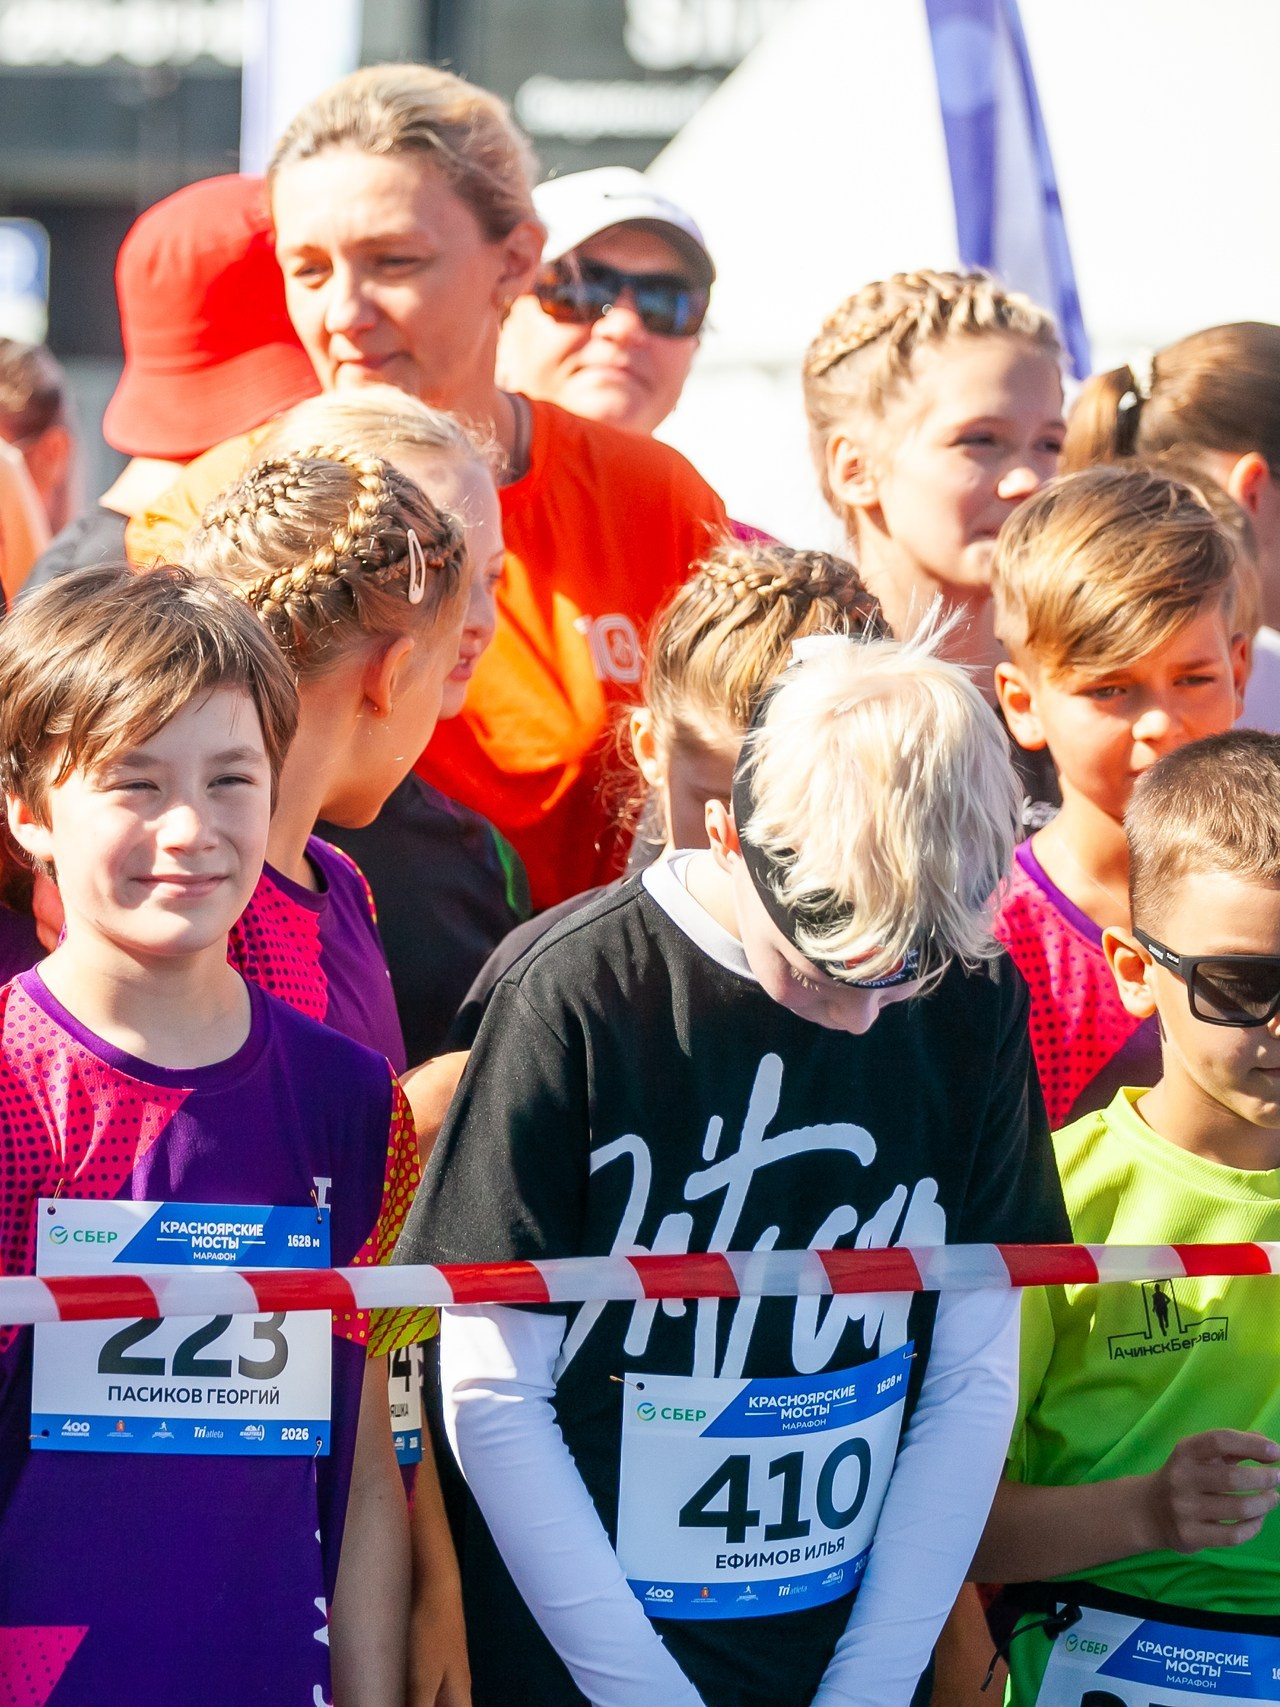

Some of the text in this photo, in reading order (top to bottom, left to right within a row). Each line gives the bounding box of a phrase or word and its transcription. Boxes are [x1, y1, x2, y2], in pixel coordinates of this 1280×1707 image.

[73, 1229, 118, 1244] СБЕР
[160, 1221, 264, 1237] КРАСНОЯРСКИЕ
[191, 1235, 239, 1250] МОСТЫ
[287, 1234, 311, 1248] 1628
[193, 1251, 236, 1261] МАРАФОН
[97, 1311, 289, 1380] 223
[876, 1376, 896, 1395] 1628
[107, 1384, 281, 1406] ПАСИКОВ ГЕОРГИЙ
[748, 1384, 856, 1408] КРАСНОЯРСКИЕ
[660, 1407, 707, 1422] СБЕР
[780, 1403, 830, 1420] МОСТЫ
[61, 1419, 91, 1433] 400
[782, 1418, 827, 1431] МАРАФОН
[281, 1427, 309, 1441] 2026
[678, 1437, 872, 1544] 410
[715, 1536, 845, 1569] ЕФИМОВ ИЛЬЯ
[645, 1585, 674, 1599] 400
[1079, 1640, 1108, 1656] СБЕР
[1136, 1639, 1249, 1667] КРАСНОЯРСКИЕ
[1165, 1658, 1221, 1678] МОСТЫ
[1166, 1674, 1217, 1688] МАРАФОН
